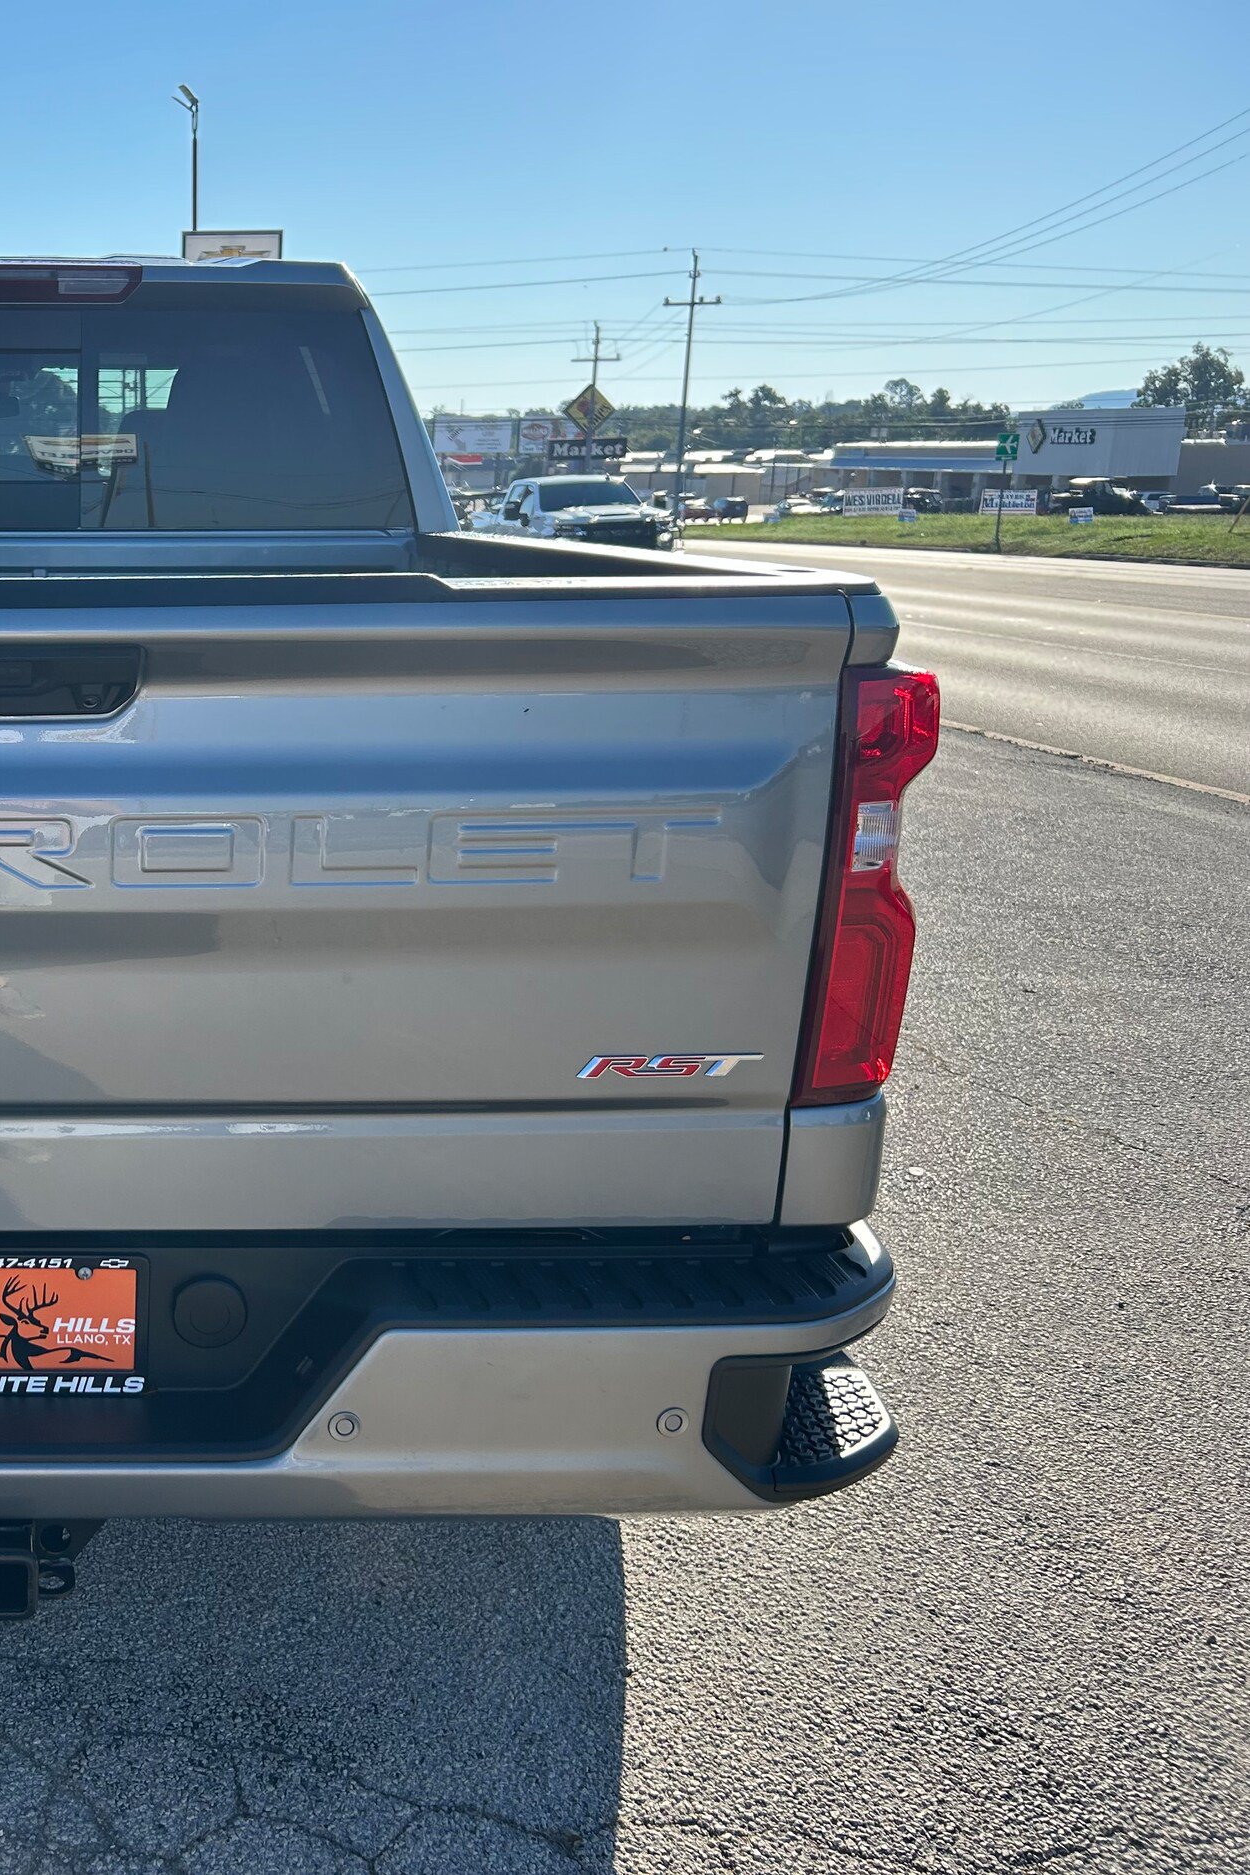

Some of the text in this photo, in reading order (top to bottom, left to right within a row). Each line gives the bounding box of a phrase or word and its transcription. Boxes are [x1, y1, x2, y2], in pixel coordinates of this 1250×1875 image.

[1050, 428, 1095, 445] Market
[845, 494, 865, 506] WES
[576, 1052, 765, 1079] RST
[53, 1317, 136, 1334] HILLS
[56, 1334, 131, 1346] LLANO, TX
[53, 1376, 146, 1394] HILLS
